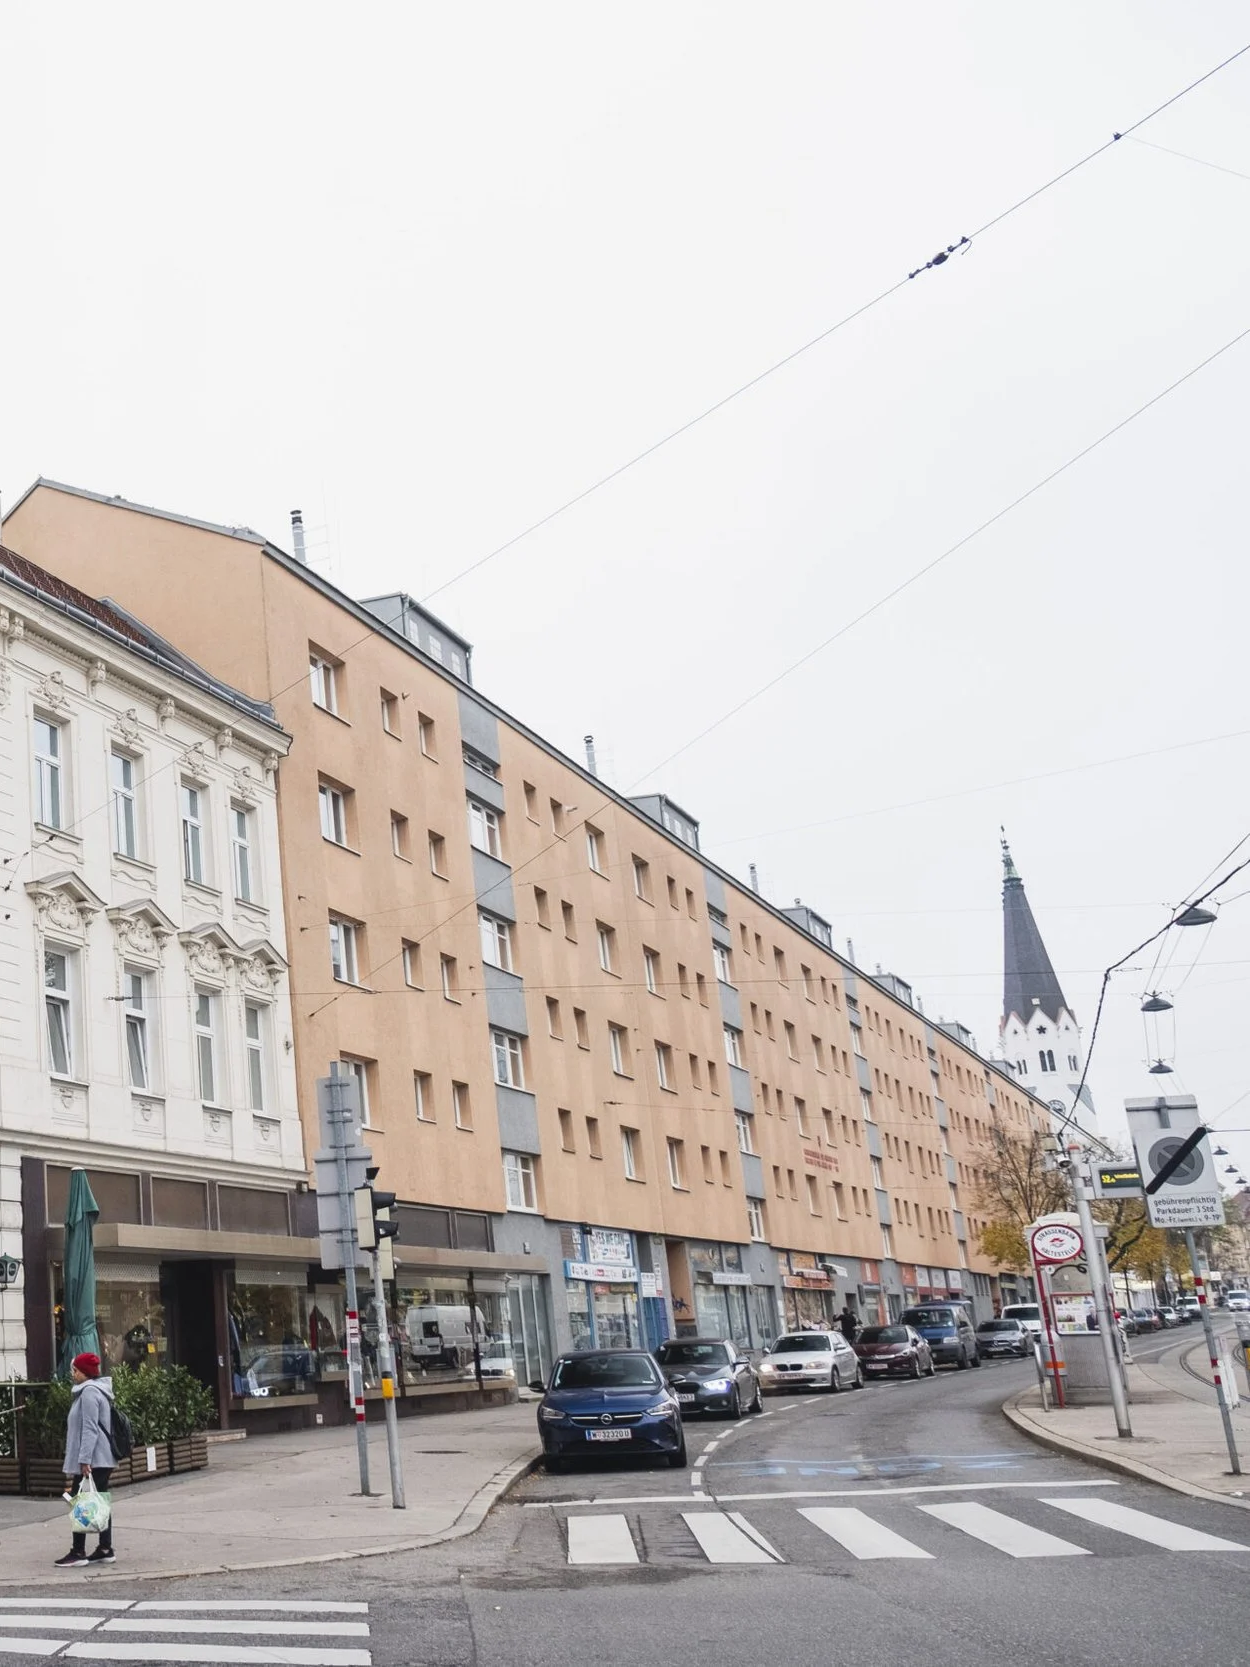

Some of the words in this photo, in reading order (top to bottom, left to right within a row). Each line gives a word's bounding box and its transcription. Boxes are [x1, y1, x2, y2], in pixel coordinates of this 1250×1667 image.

[1153, 1196, 1217, 1207] gebührenpflichtig
[1156, 1206, 1195, 1215] Parkdauer:
[1202, 1205, 1216, 1213] Std.
